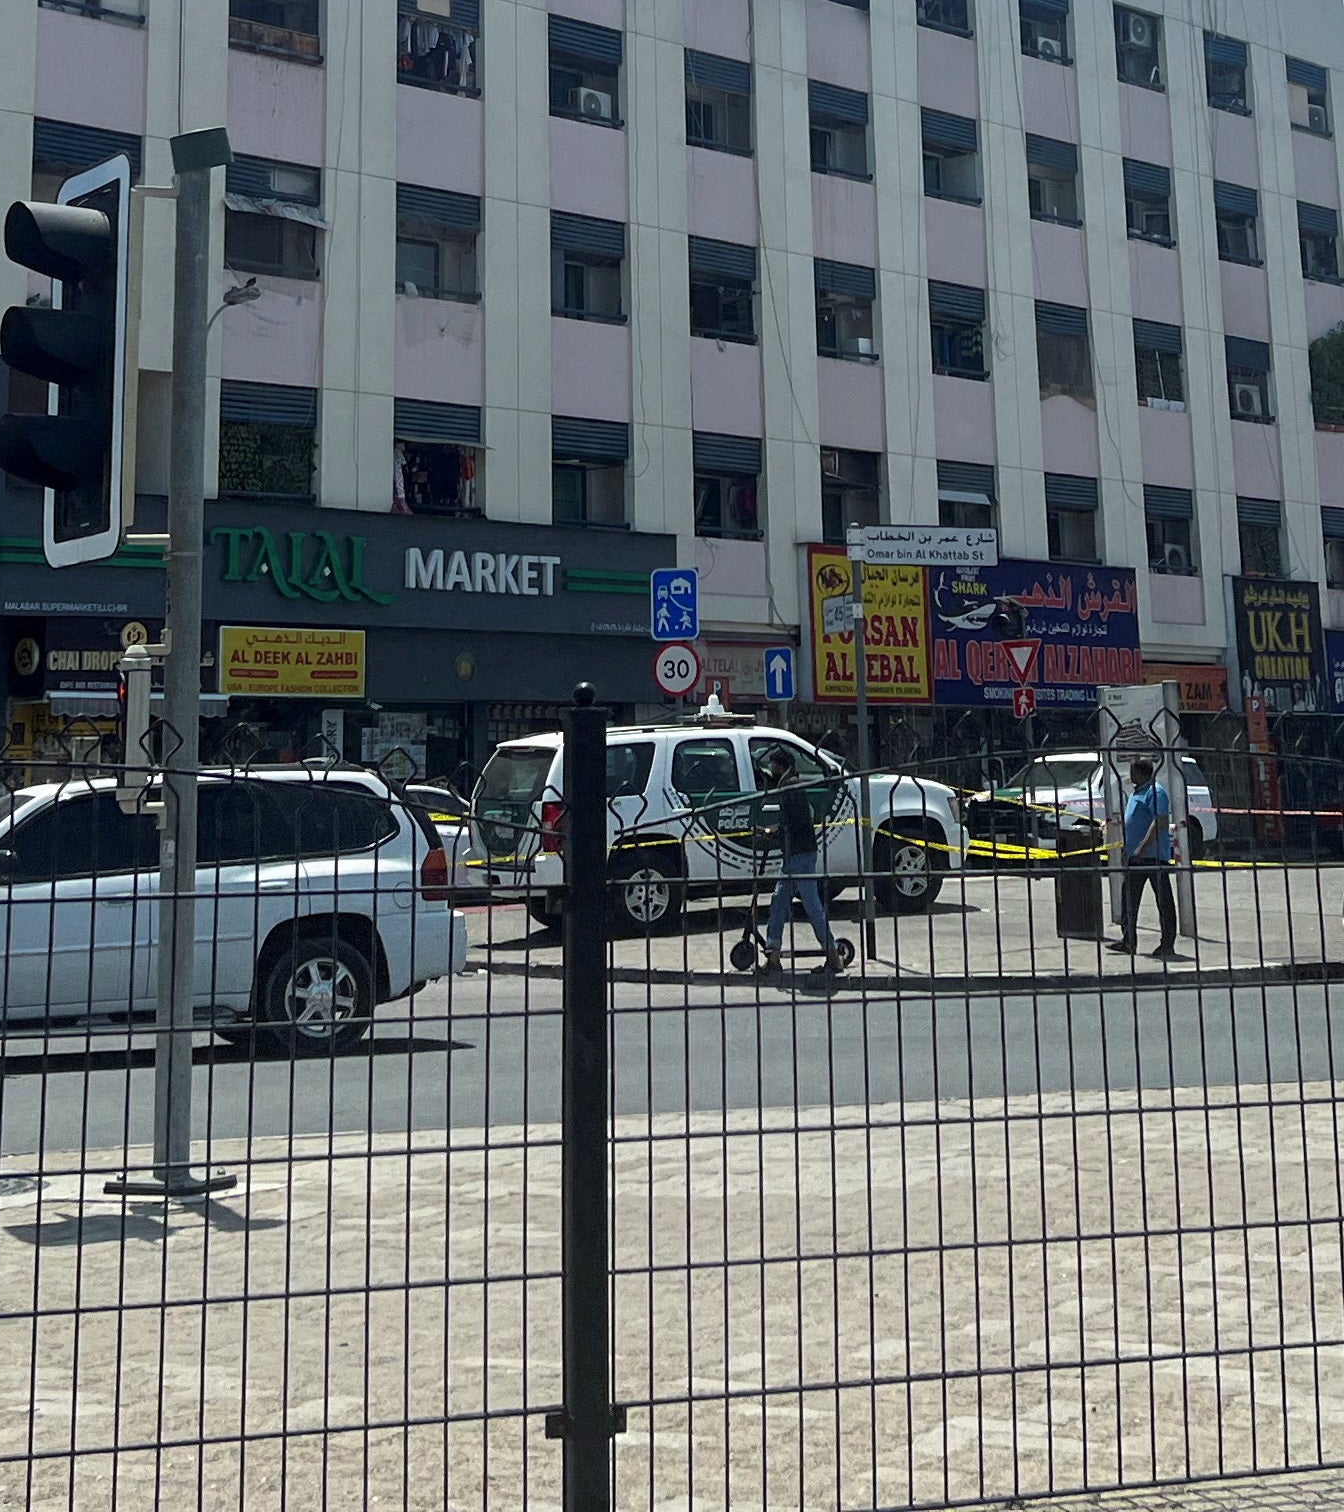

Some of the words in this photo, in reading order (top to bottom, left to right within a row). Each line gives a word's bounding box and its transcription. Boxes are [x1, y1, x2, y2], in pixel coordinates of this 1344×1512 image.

[867, 531, 914, 542] الخطاب
[918, 533, 932, 545] بن
[937, 534, 959, 545] عمر
[966, 533, 995, 546] شارع
[867, 549, 894, 559] Omar
[897, 549, 912, 559] bin
[916, 550, 926, 560] Al
[929, 550, 969, 560] Khattab
[972, 551, 984, 561] St
[210, 526, 400, 606] TALAL
[405, 547, 561, 597] MARKET
[951, 580, 987, 596] SHARK
[1078, 571, 1136, 622] القرش
[4, 601, 41, 611] MALABAR
[246, 632, 302, 647] الذهبي
[306, 632, 346, 647] الديك
[48, 650, 80, 671] CHAI
[231, 649, 250, 664] AL
[254, 650, 291, 665] DEEK
[295, 651, 313, 665] AL
[316, 652, 358, 666] ZAHBI
[934, 638, 962, 681] AL
[663, 659, 690, 679] 30
[825, 651, 854, 682] AL
[865, 653, 921, 684] EBAL
[1254, 655, 1311, 680] CREATION
[248, 684, 280, 693] EUROPE
[1185, 682, 1213, 701] ZAM
[717, 818, 750, 830] POLICE
